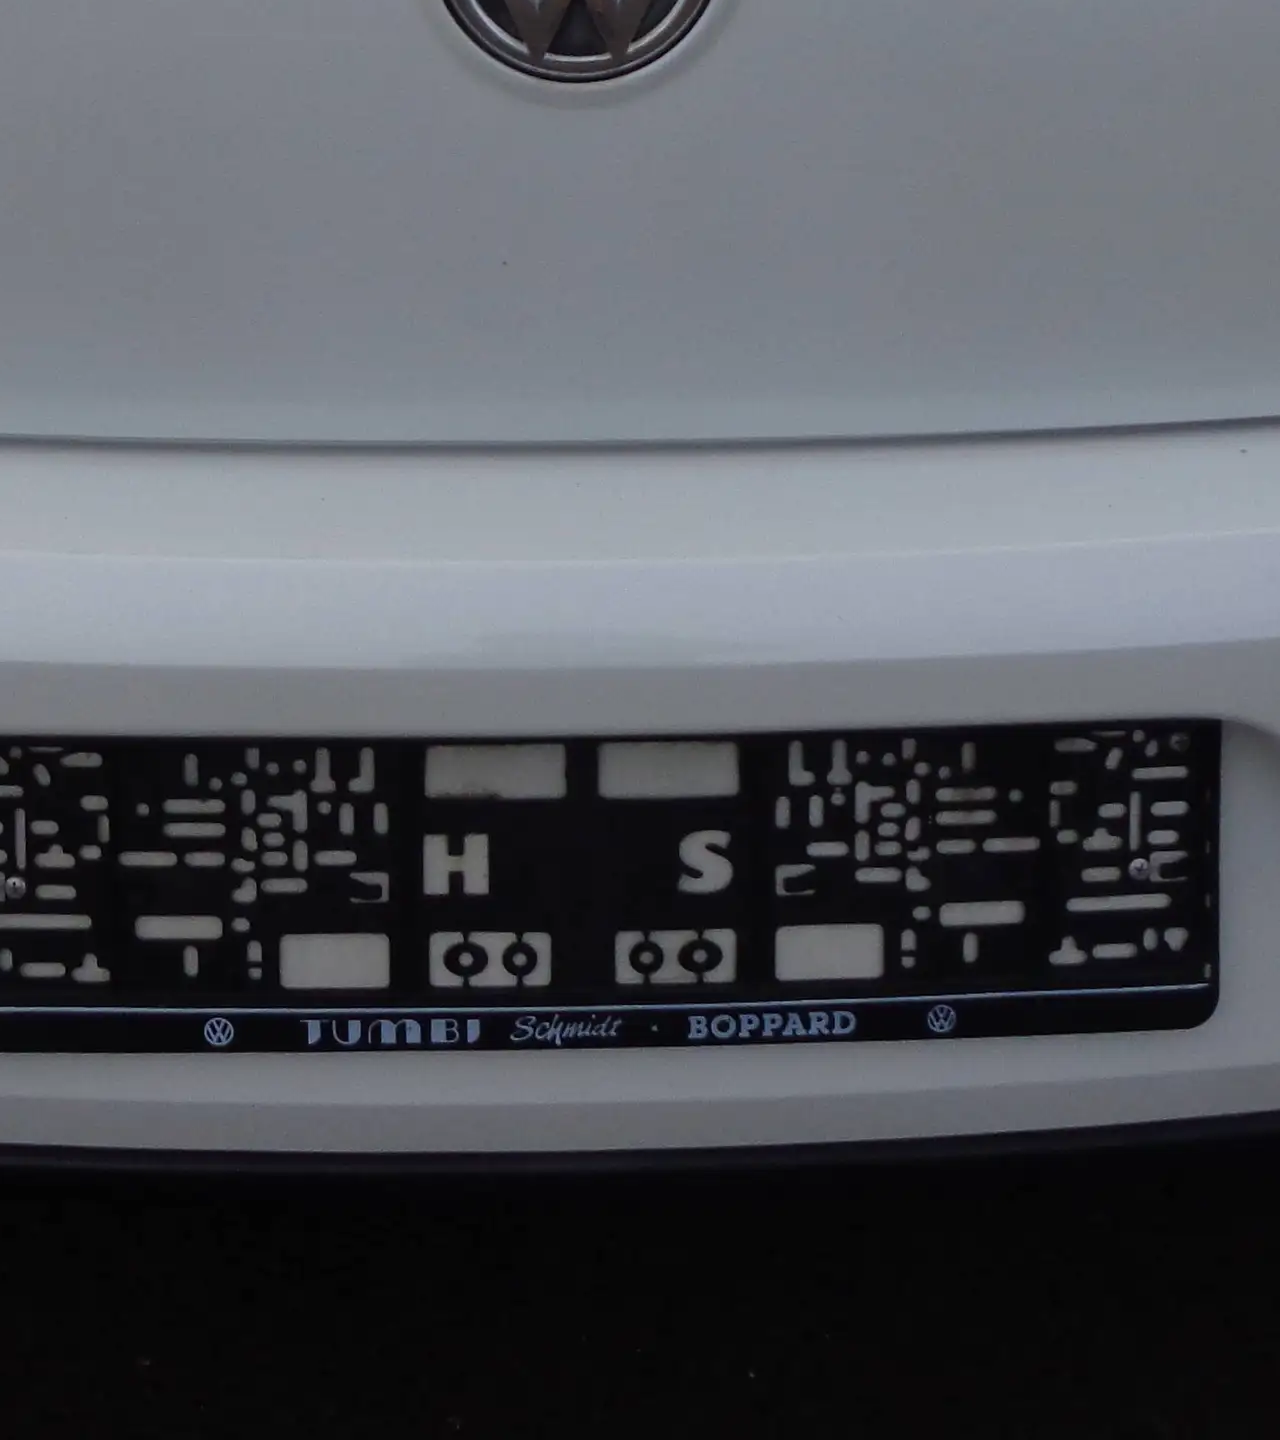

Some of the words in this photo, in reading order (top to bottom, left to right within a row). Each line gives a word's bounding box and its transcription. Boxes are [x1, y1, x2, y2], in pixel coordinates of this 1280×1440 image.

[423, 832, 489, 895] H
[676, 829, 734, 894] S
[509, 1013, 622, 1048] Schmidt
[687, 1010, 858, 1040] BOPPARD
